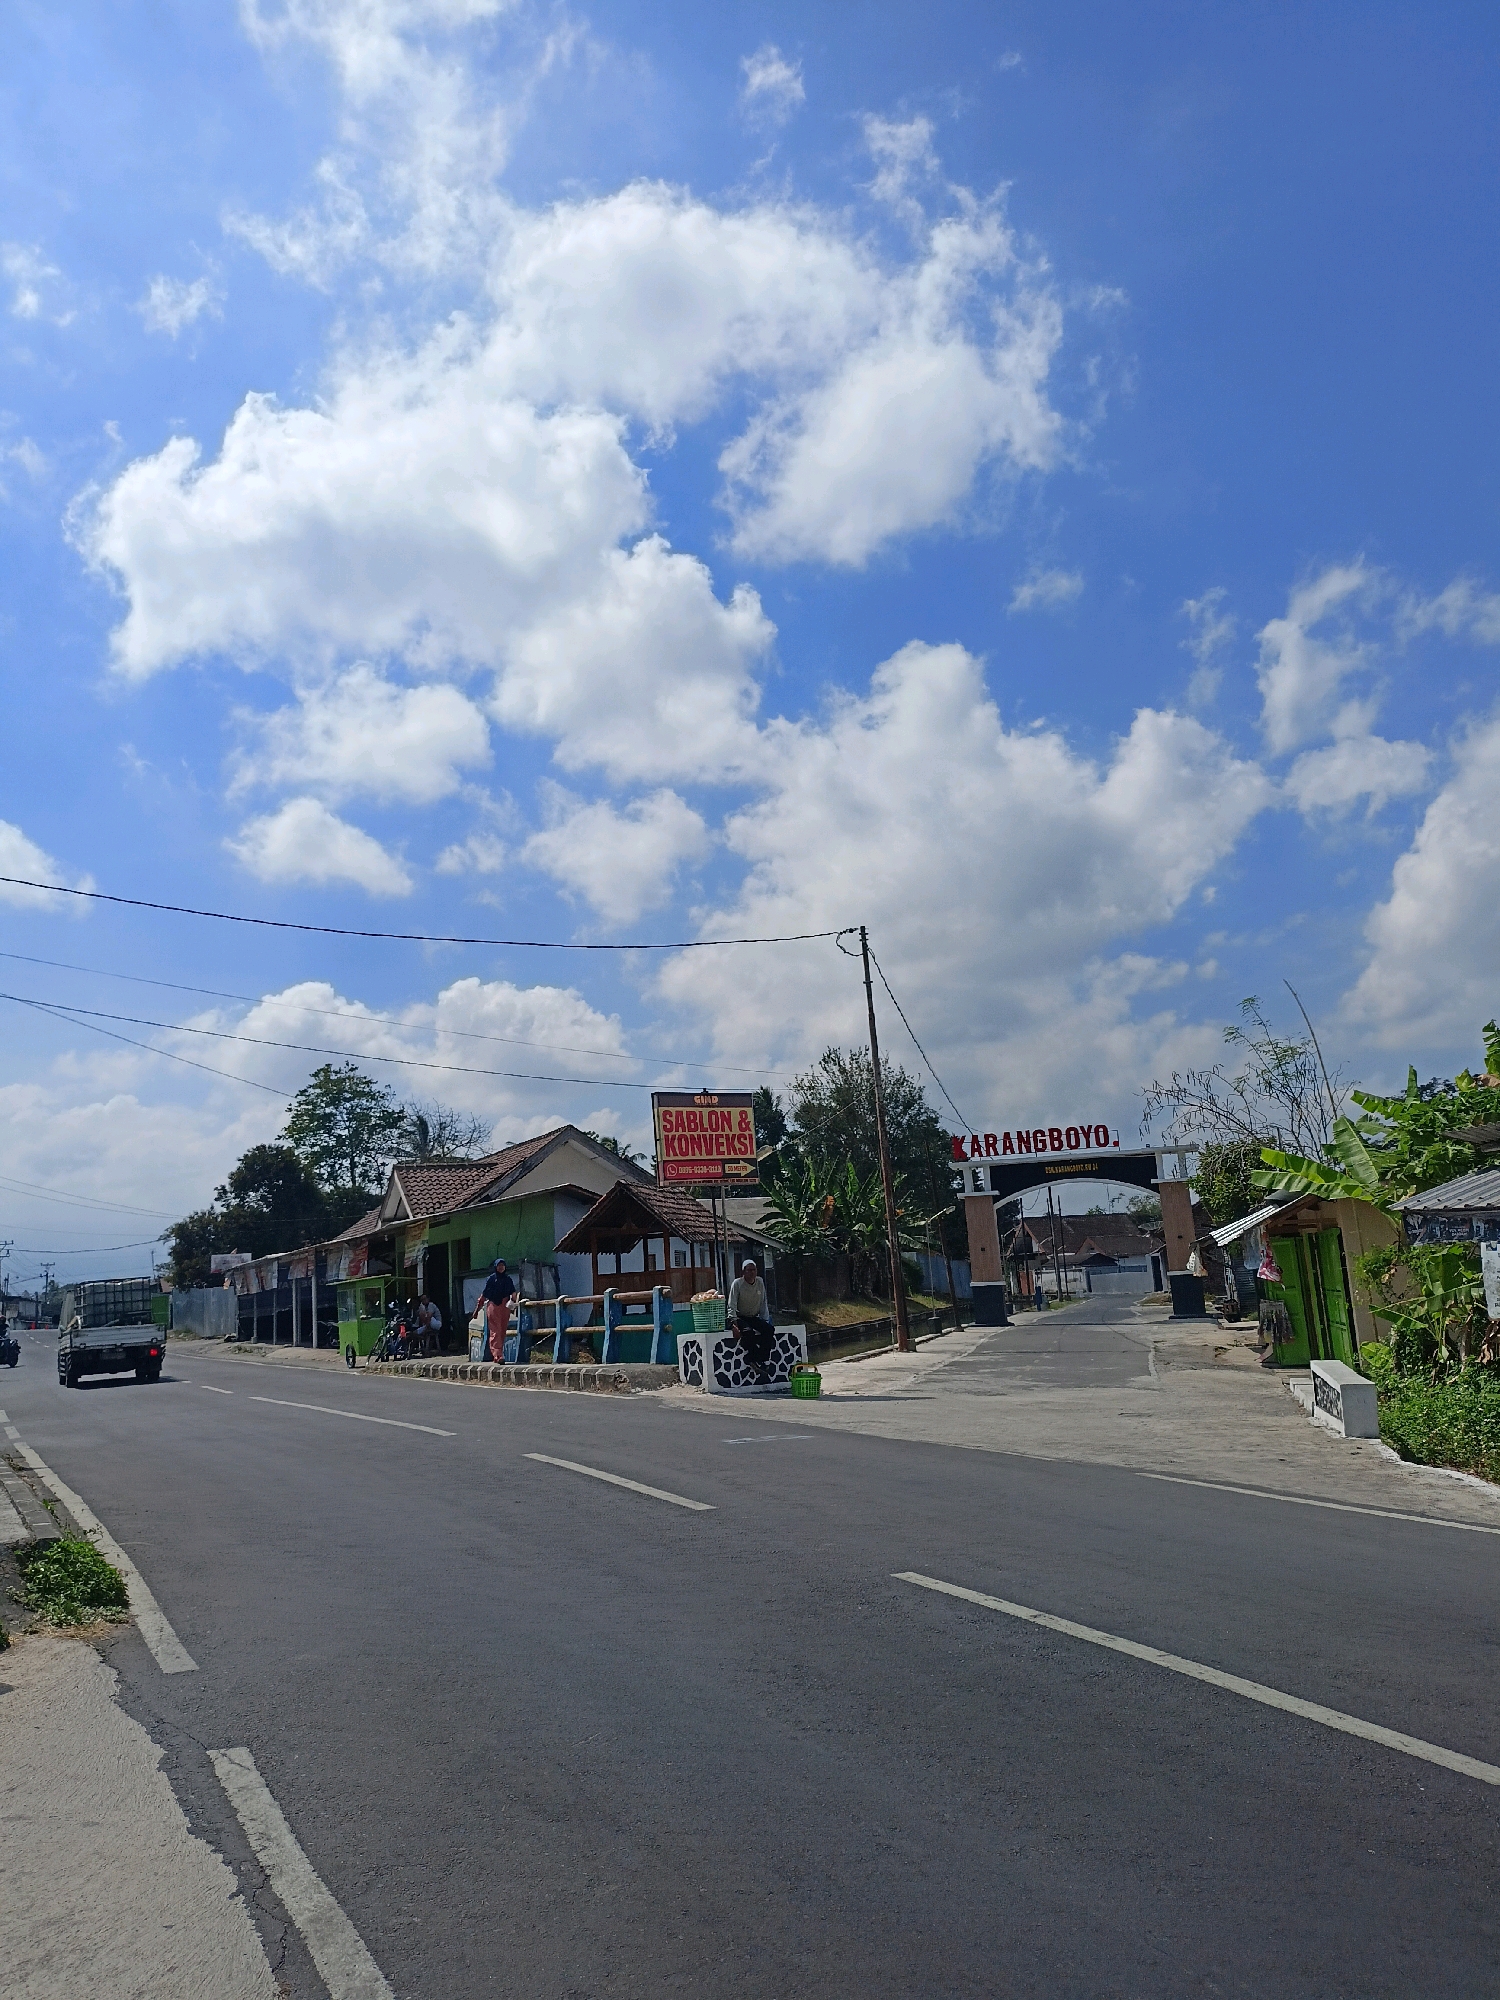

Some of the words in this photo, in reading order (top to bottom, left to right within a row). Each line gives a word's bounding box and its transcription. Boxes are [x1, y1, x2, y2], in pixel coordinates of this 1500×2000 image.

[662, 1110, 733, 1133] SABLON
[737, 1110, 752, 1133] &
[664, 1133, 755, 1157] KONVEKSI
